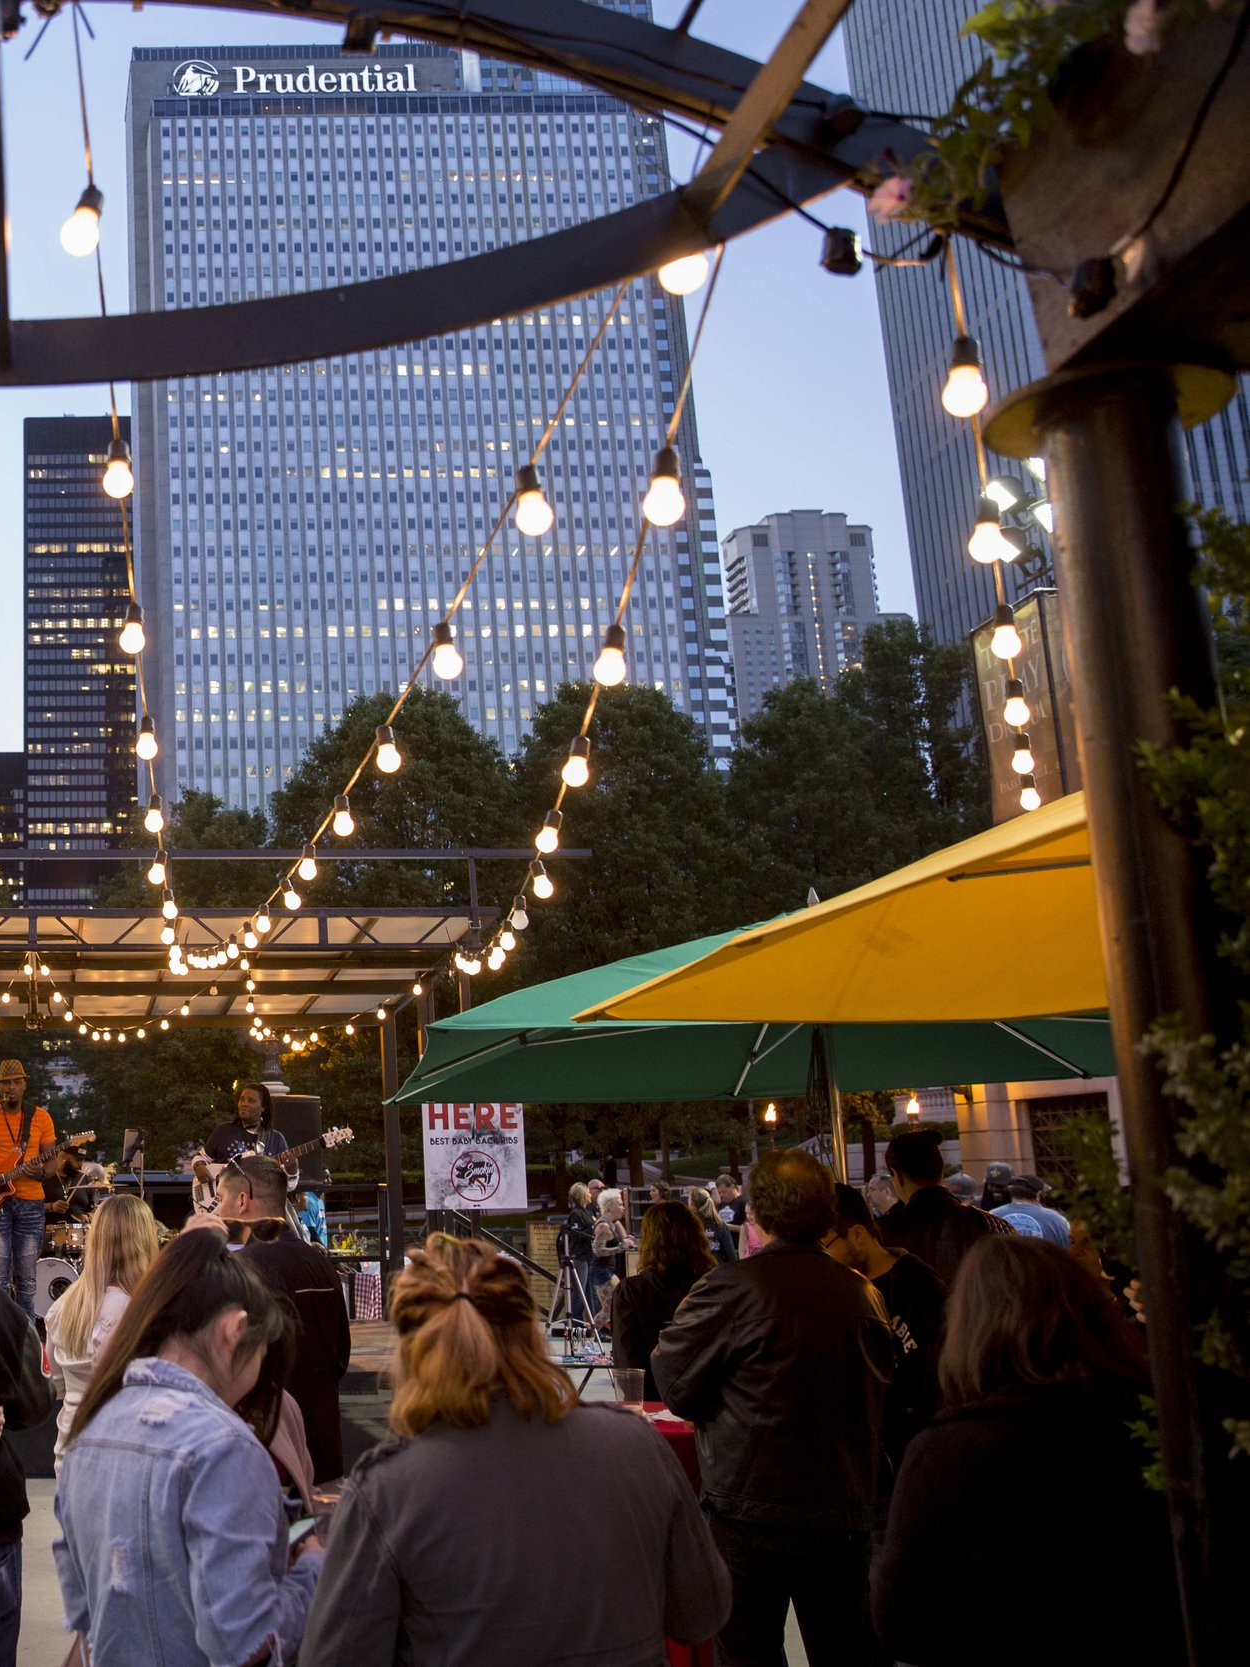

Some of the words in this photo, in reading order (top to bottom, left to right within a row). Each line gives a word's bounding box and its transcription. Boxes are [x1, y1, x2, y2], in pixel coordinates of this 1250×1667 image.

[232, 63, 418, 94] Prudential
[428, 1103, 518, 1130] HERE
[430, 1137, 449, 1145] BEST
[452, 1137, 472, 1145] BABY
[476, 1137, 498, 1145] BACK
[501, 1136, 518, 1144] RIBS
